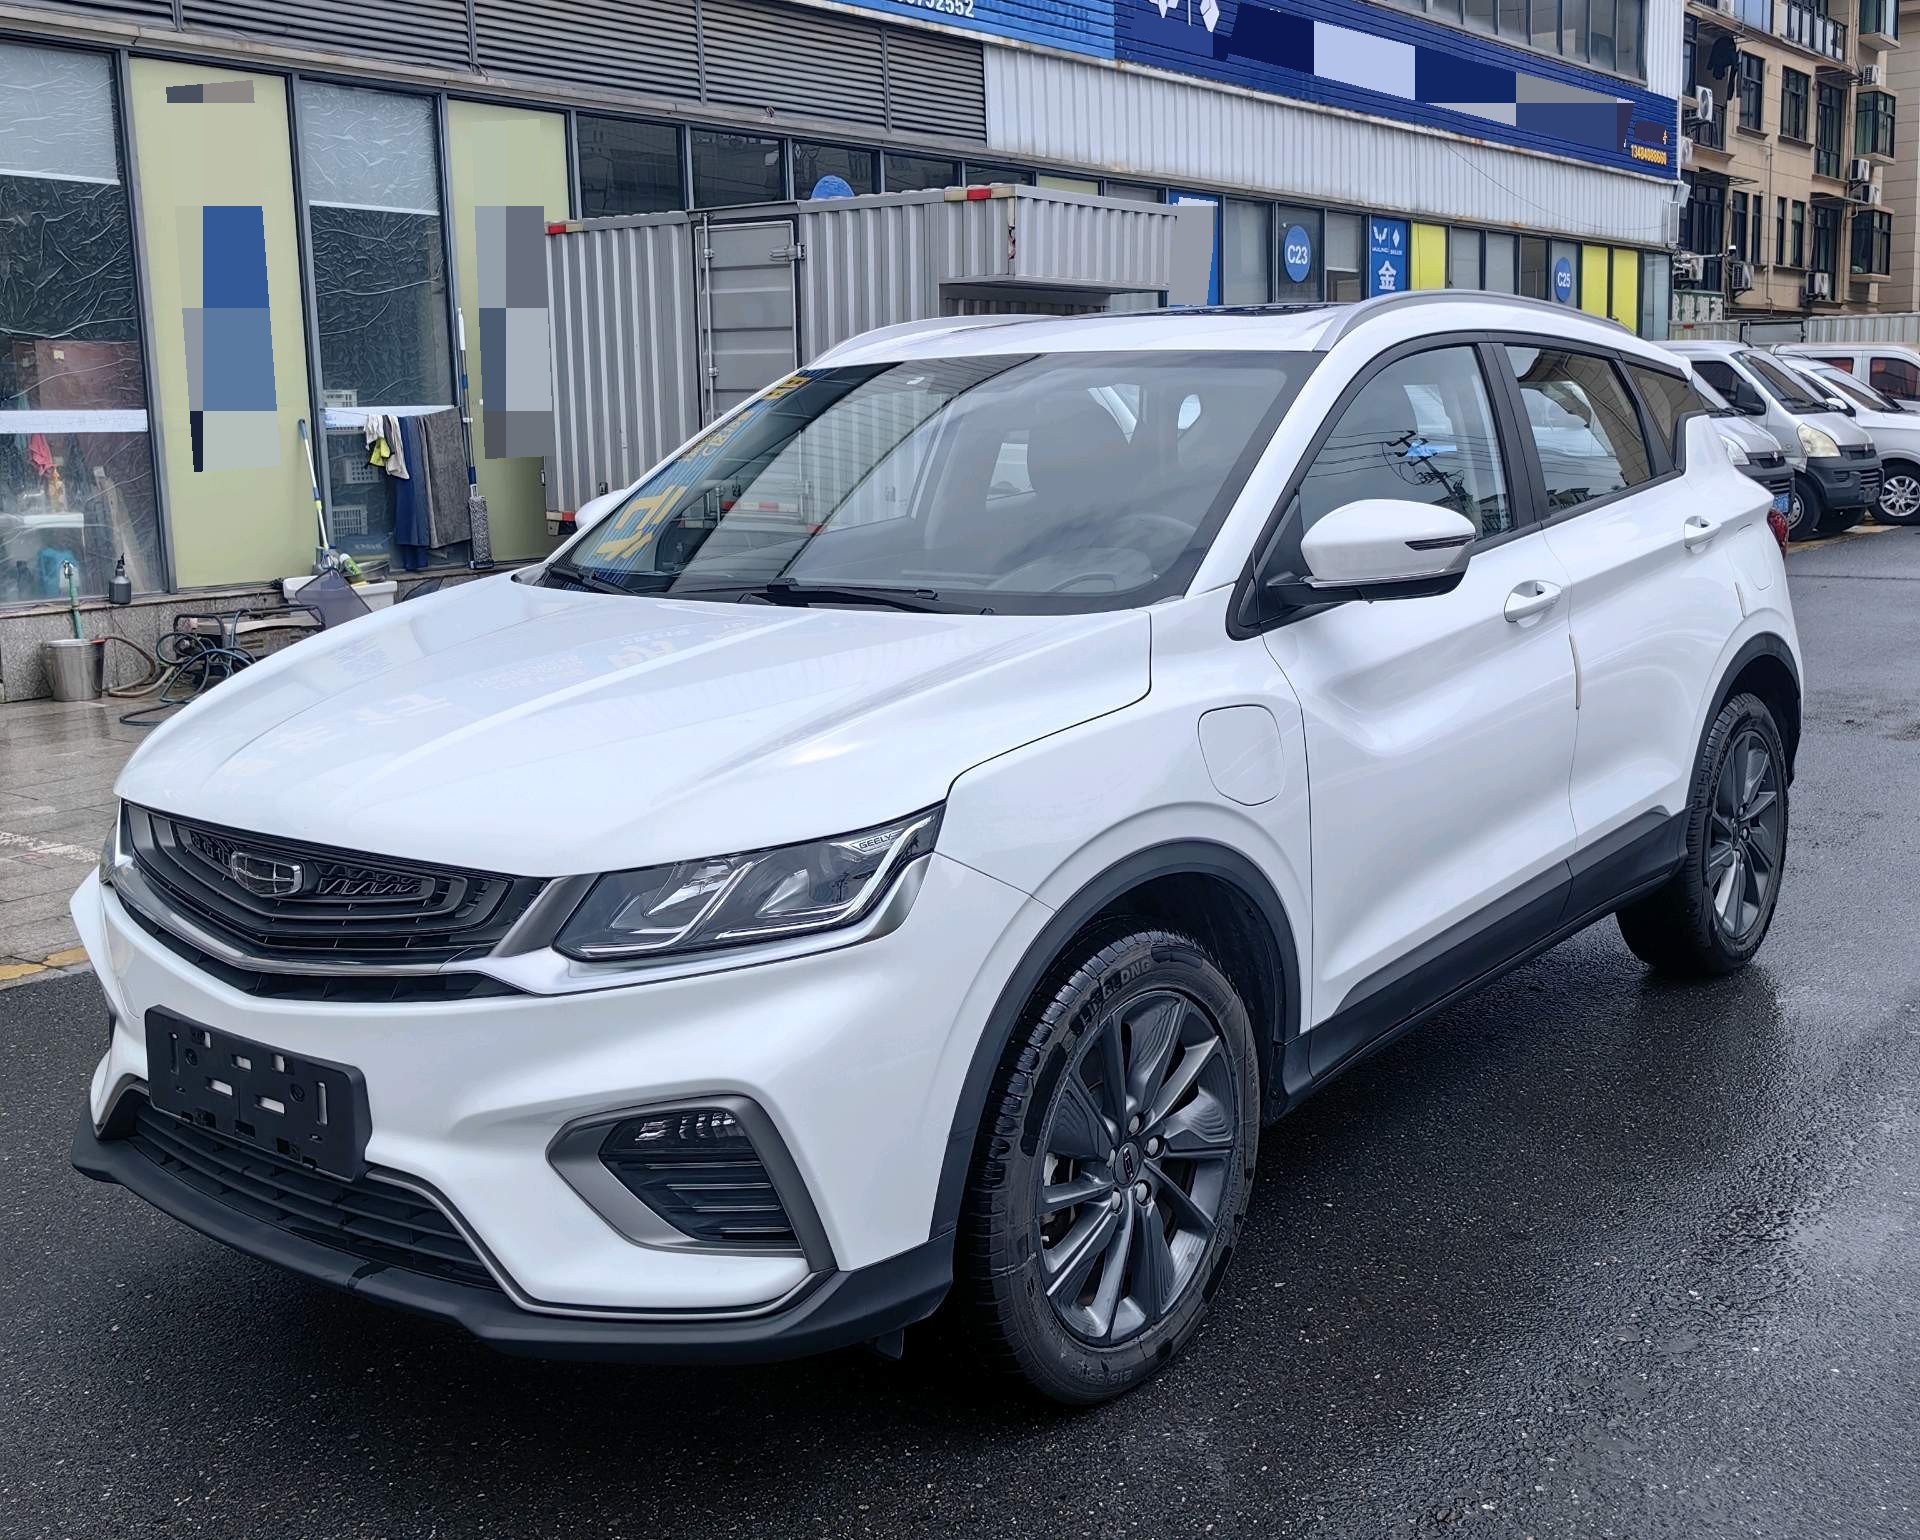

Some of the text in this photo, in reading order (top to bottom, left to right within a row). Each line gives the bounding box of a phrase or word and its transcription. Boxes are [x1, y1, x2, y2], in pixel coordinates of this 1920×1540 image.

[1287, 244, 1309, 265] C23
[1378, 260, 1397, 290] 金
[1557, 271, 1571, 288] C25
[858, 833, 893, 849] GEELY
